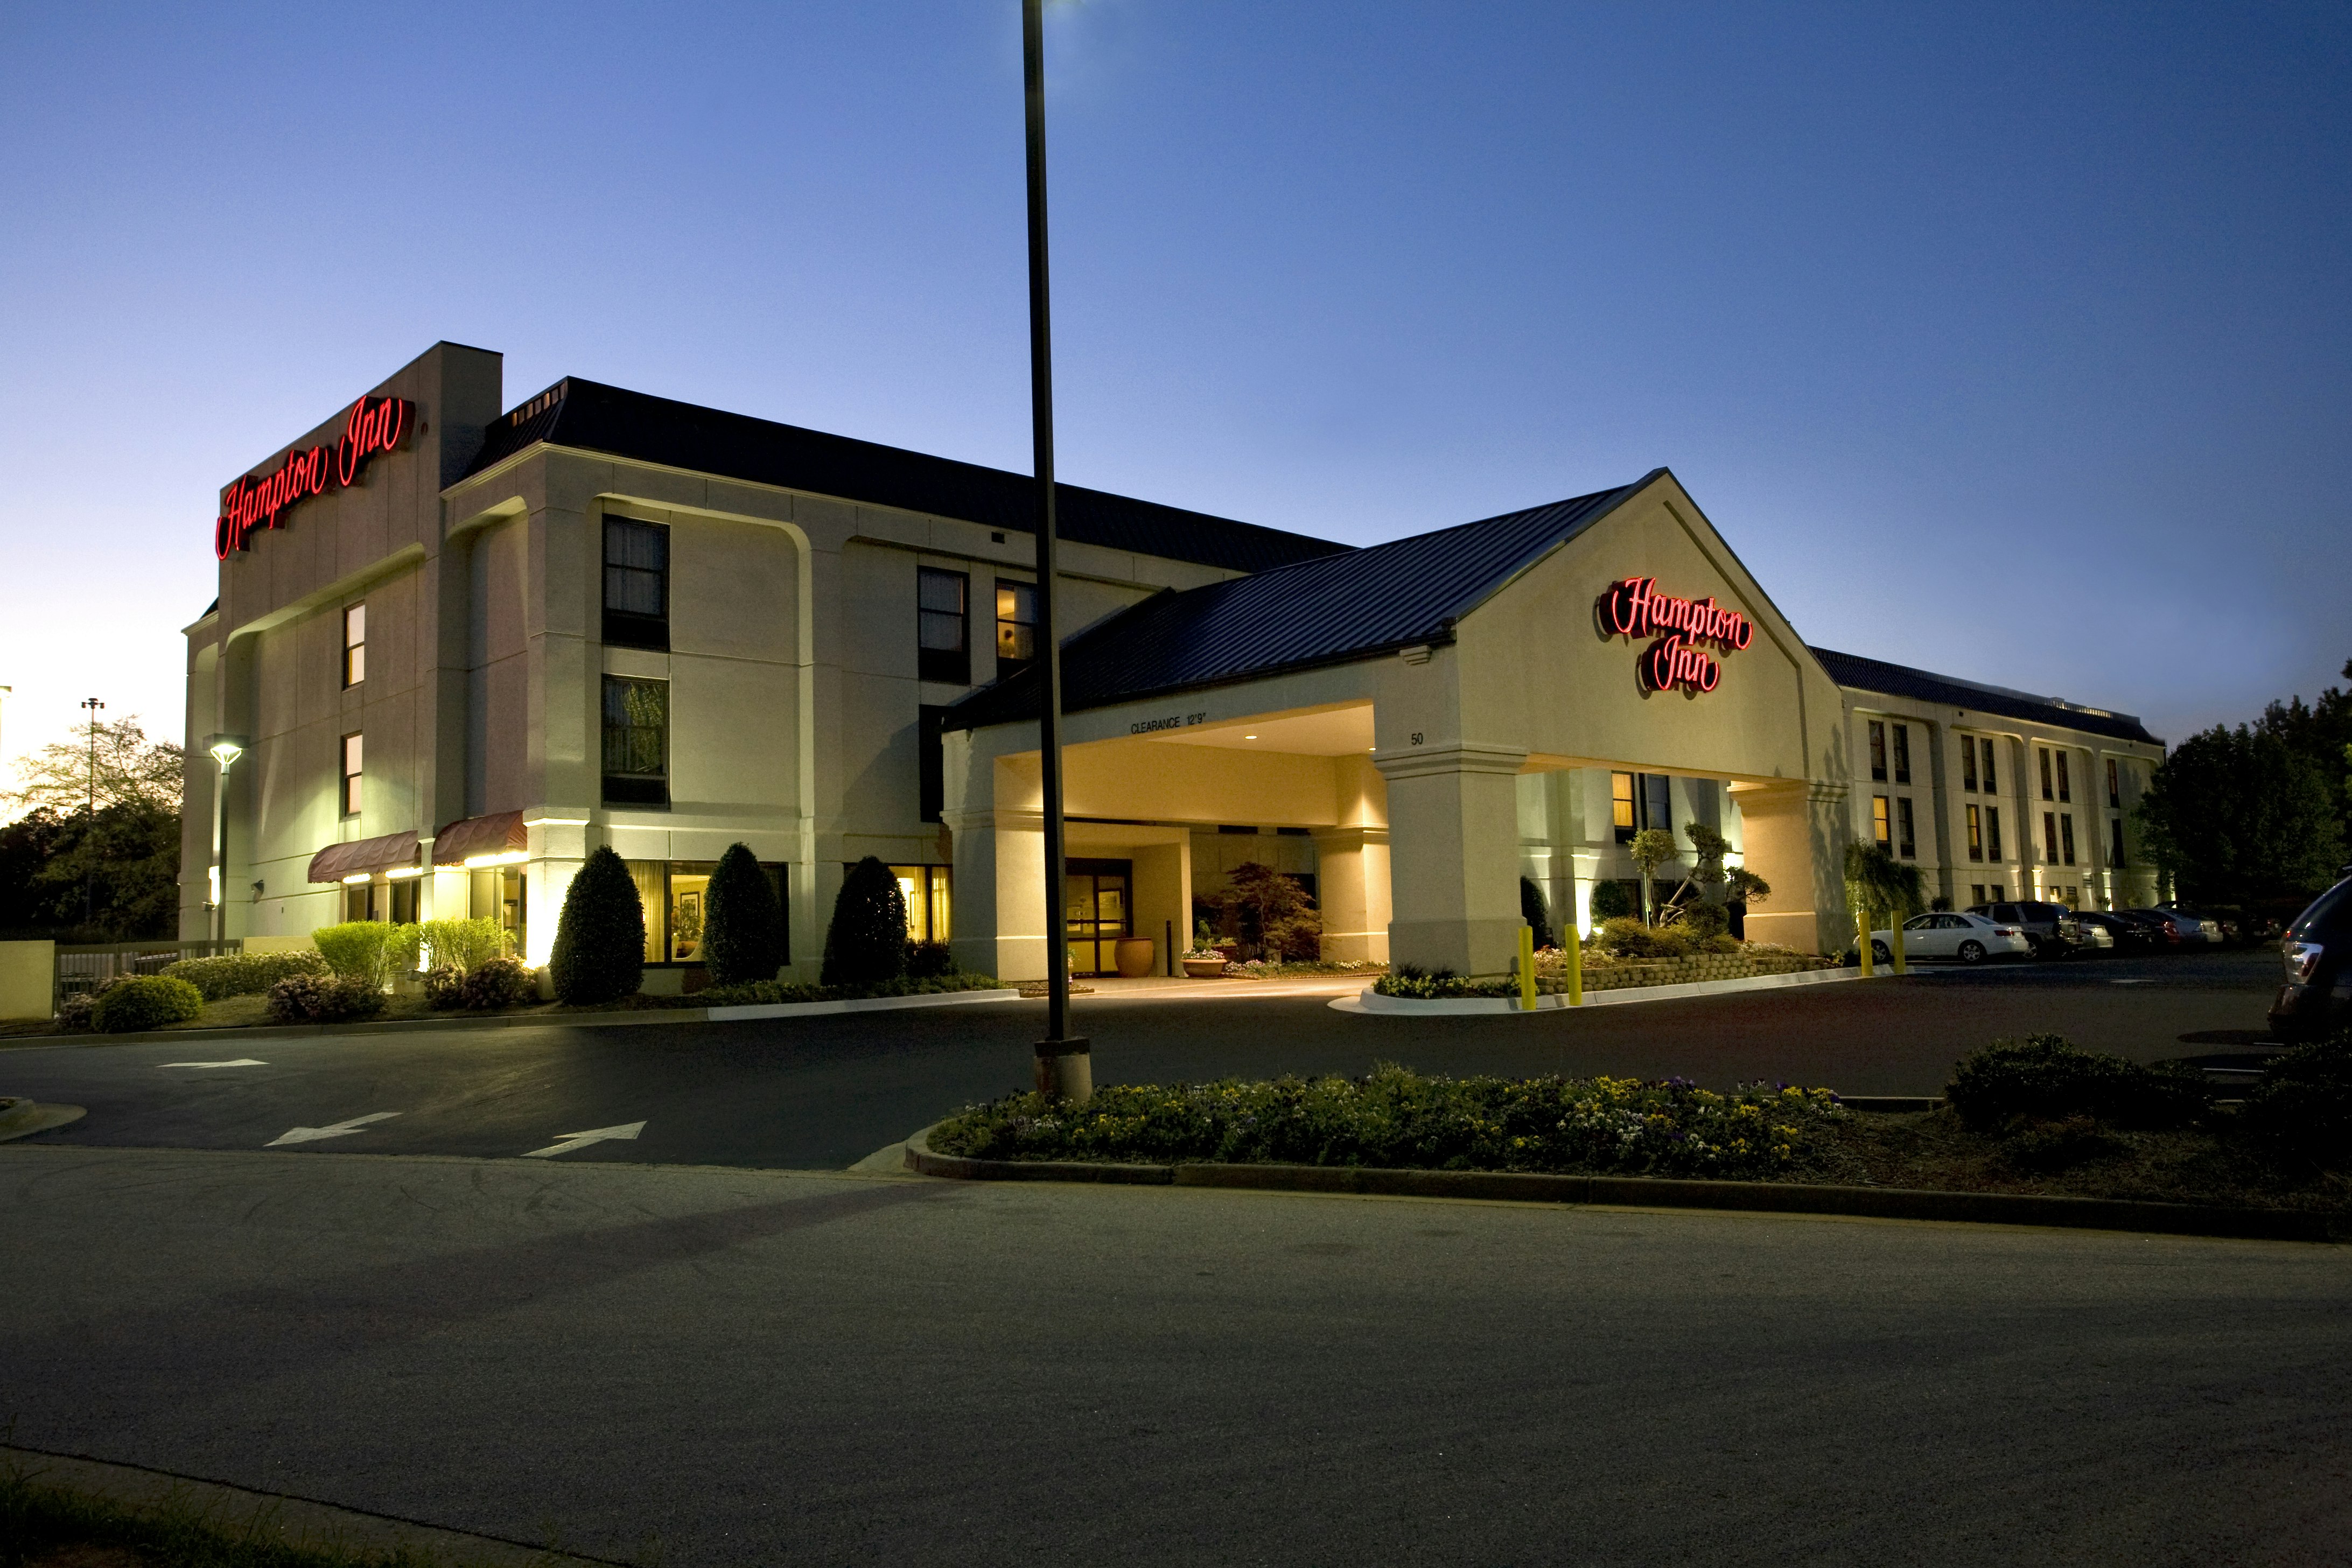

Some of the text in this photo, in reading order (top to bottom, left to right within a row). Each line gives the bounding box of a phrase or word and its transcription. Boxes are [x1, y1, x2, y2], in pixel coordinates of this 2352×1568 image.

[216, 395, 402, 561] Hampton Inn
[1612, 577, 1753, 650] Hampton
[1655, 635, 1720, 691] Inn
[1131, 716, 1180, 734] CLEARANCE
[1411, 733, 1423, 745] 50
